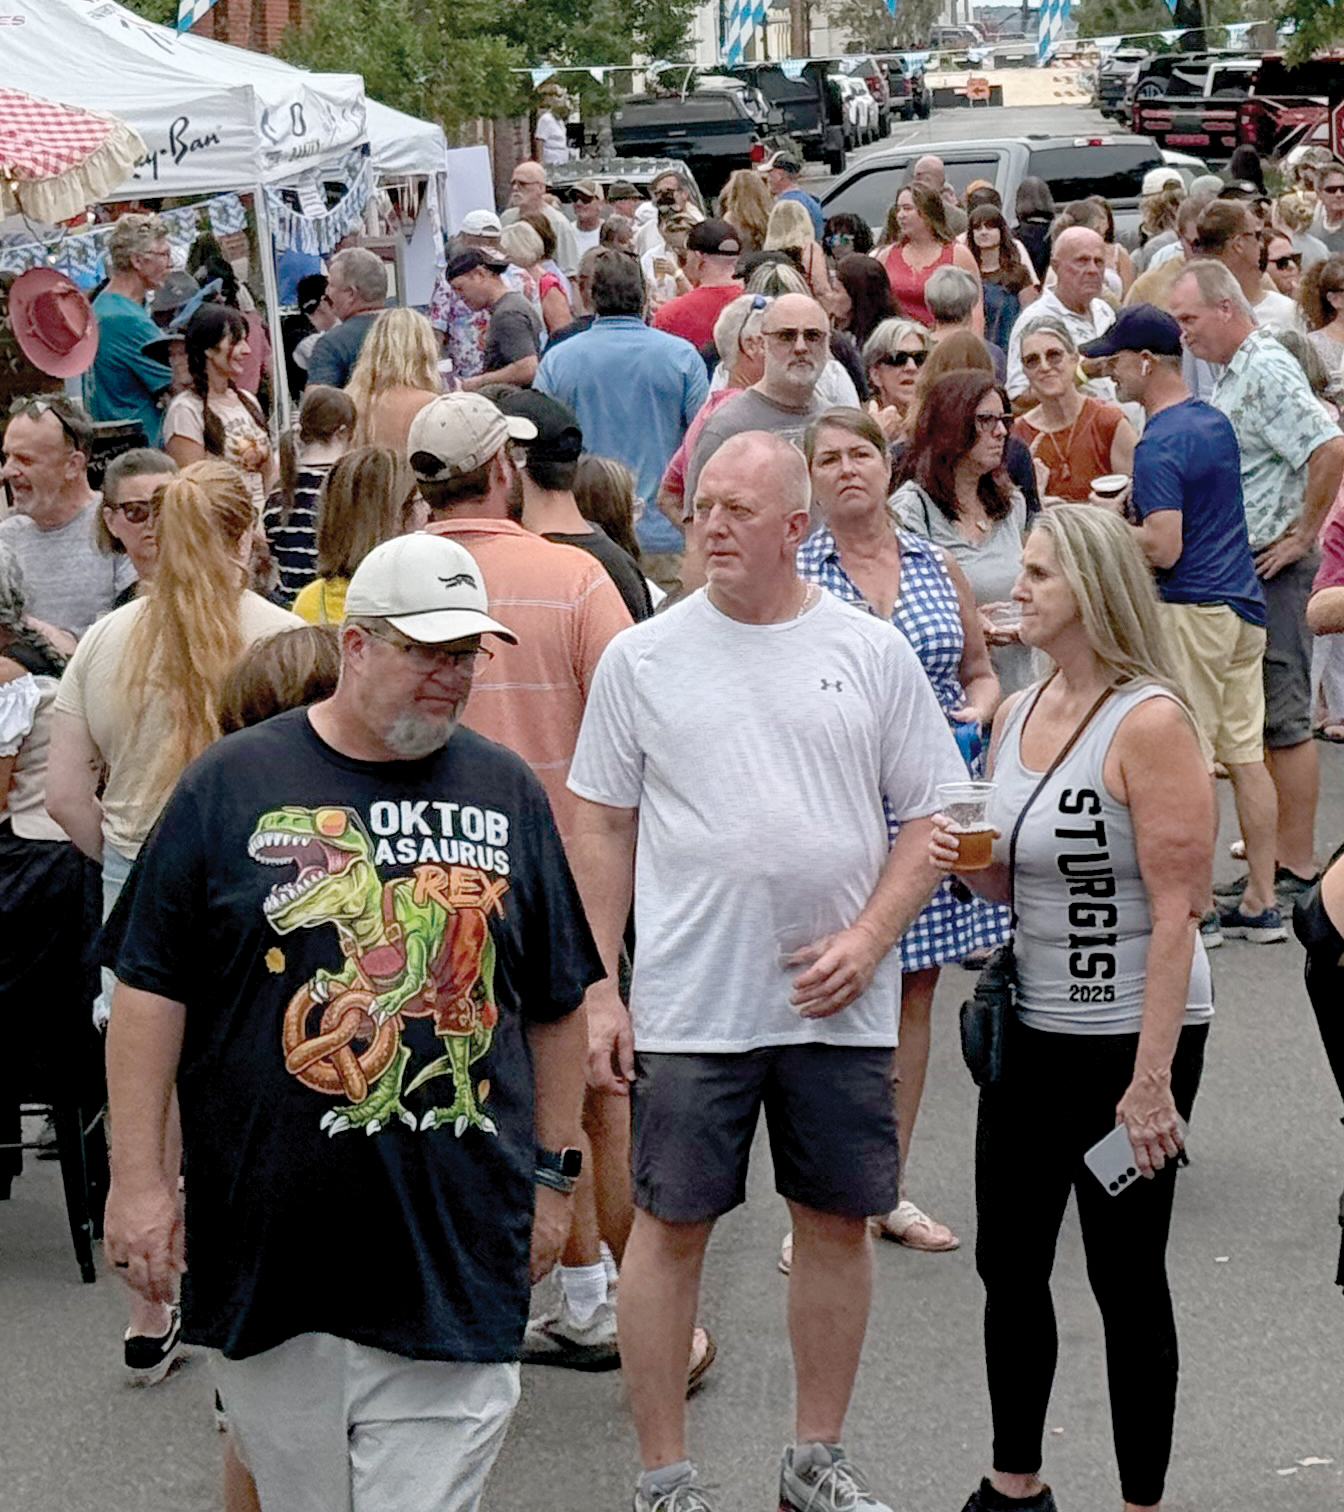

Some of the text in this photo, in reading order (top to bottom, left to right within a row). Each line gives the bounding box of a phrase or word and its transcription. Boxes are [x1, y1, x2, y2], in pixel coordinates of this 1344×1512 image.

[369, 800, 510, 848] OKTOB
[373, 838, 511, 876] ASAURUS
[412, 863, 511, 921] REX
[1054, 788, 1118, 980] STURGIS
[1069, 984, 1116, 1003] 2025
